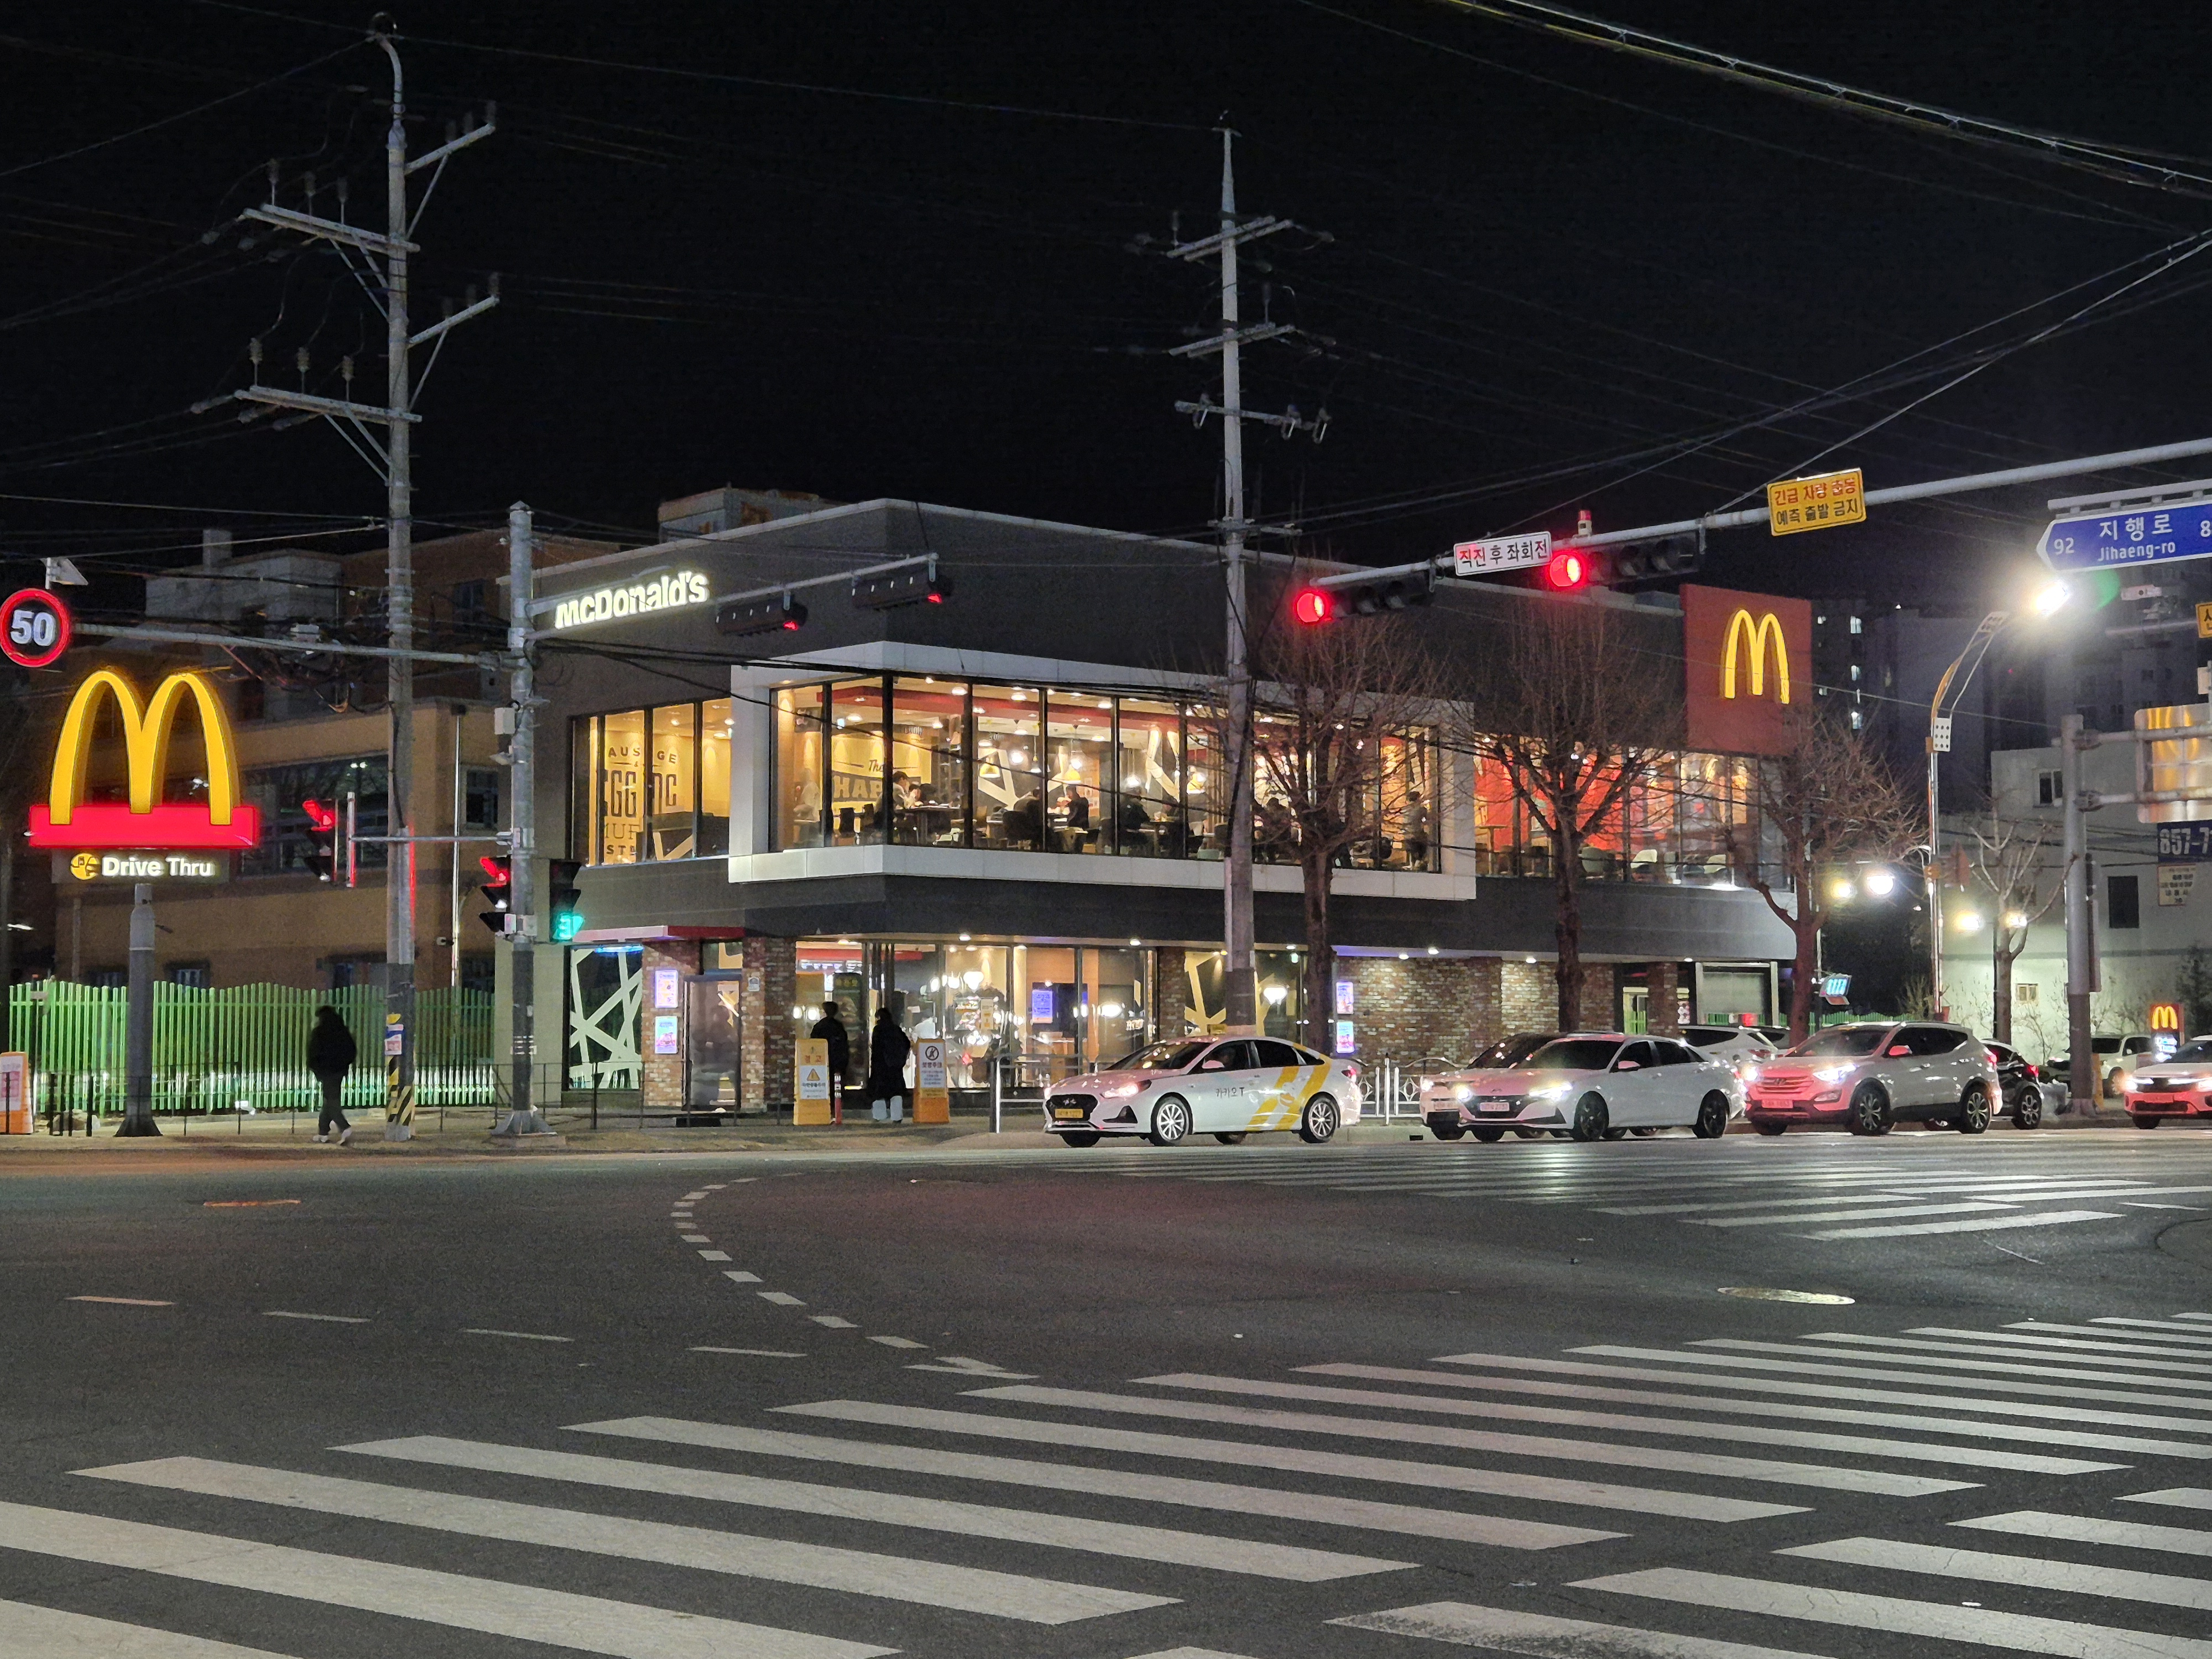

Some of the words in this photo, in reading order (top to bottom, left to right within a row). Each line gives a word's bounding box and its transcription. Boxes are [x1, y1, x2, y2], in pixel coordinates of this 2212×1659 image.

[1775, 487, 1799, 506] 긴급
[1804, 482, 1827, 500] 차량
[1776, 508, 1801, 525] 예측
[1805, 503, 1829, 521] 출발
[1834, 498, 1858, 517] 금지
[2099, 513, 2173, 542] 지행로
[2200, 520, 2212, 538] 8
[1459, 546, 1486, 568] 직진
[1489, 544, 1503, 565] 후
[1507, 539, 1548, 562] 좌회전
[2053, 537, 2075, 555] 92
[2098, 541, 2176, 562] Jihaeng-ro
[554, 570, 710, 630] McDonald's
[10, 609, 55, 646] 50
[2159, 827, 2212, 855] 857-7
[101, 856, 164, 877] Drive
[165, 856, 215, 877] Thru
[1215, 1087, 1238, 1098] 카카오
[1239, 1087, 1245, 1097] T
